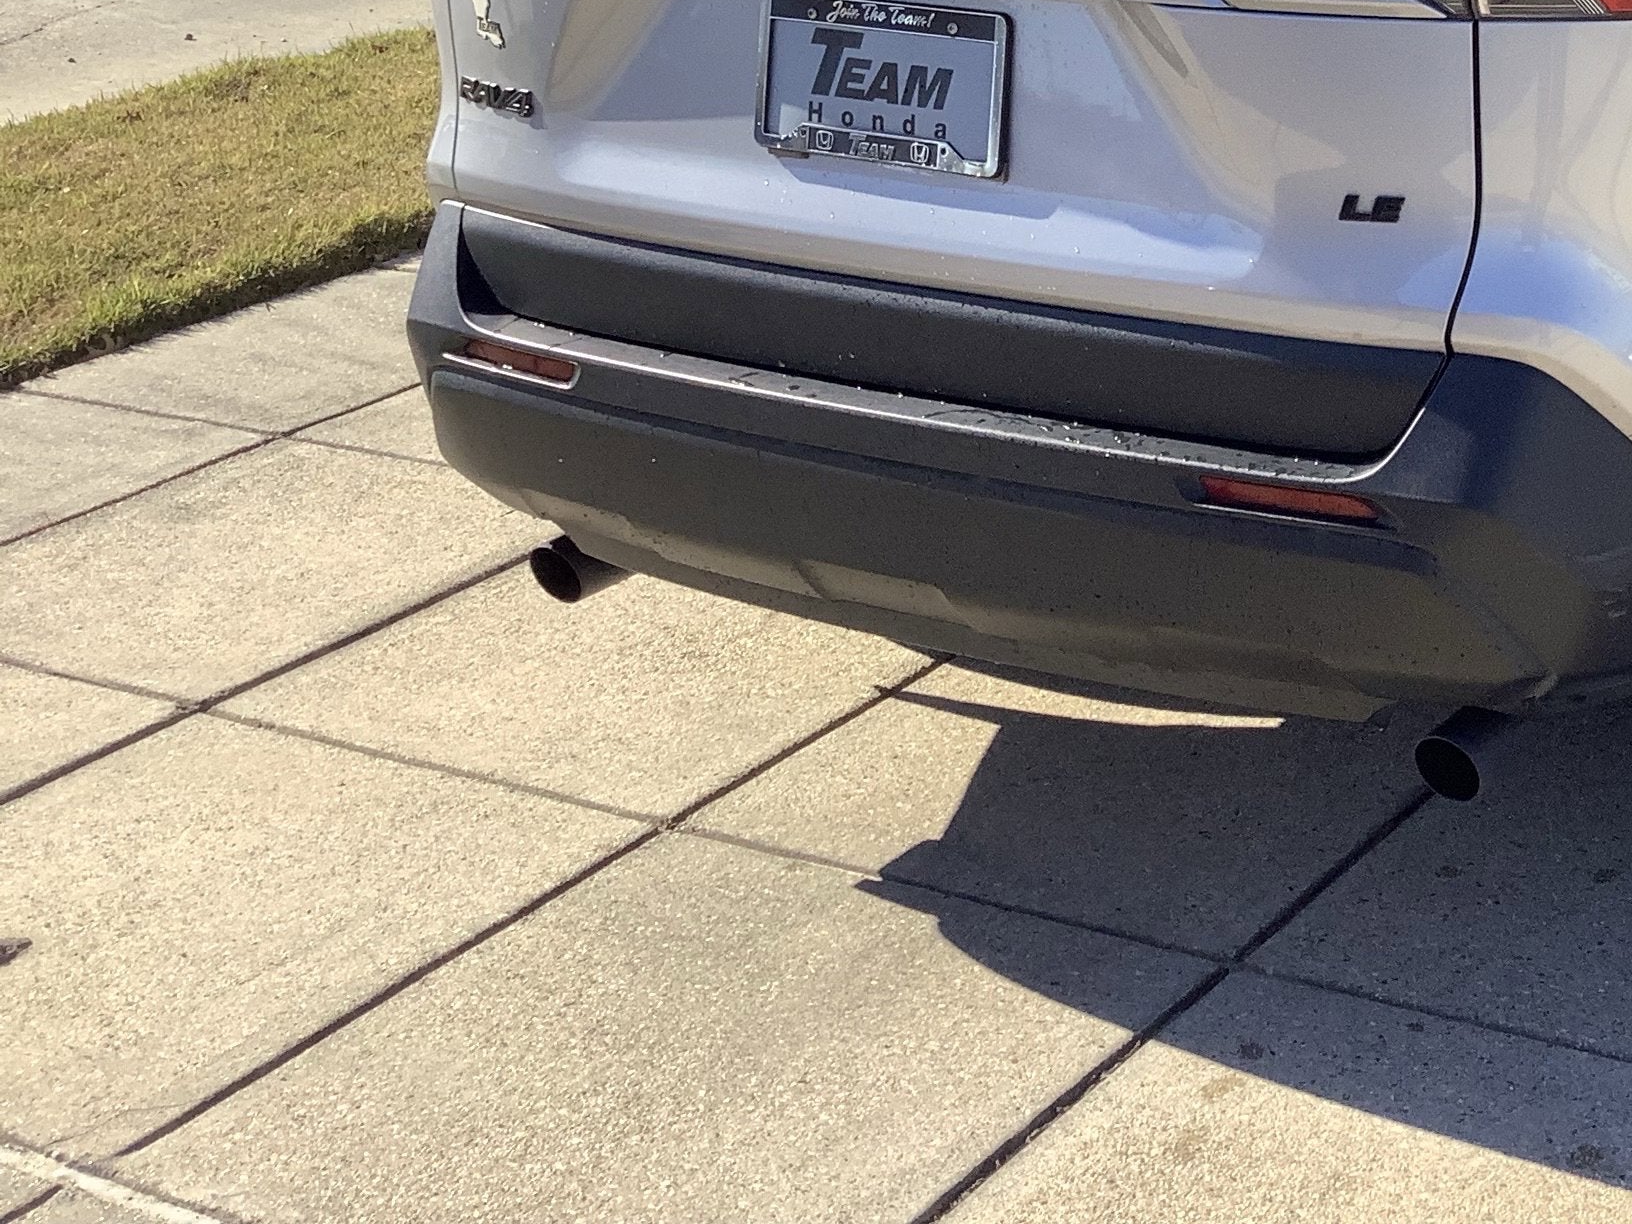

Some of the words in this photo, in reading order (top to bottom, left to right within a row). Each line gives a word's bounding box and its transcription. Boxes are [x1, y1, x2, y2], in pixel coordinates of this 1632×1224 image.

[826, 0, 860, 23] Join
[861, 3, 887, 22] The
[888, 6, 935, 28] Team!
[811, 27, 954, 111] TEAM
[460, 75, 535, 118] RAV4
[808, 100, 947, 140] Honda
[849, 134, 895, 161] TEAM
[1338, 193, 1406, 223] LE
